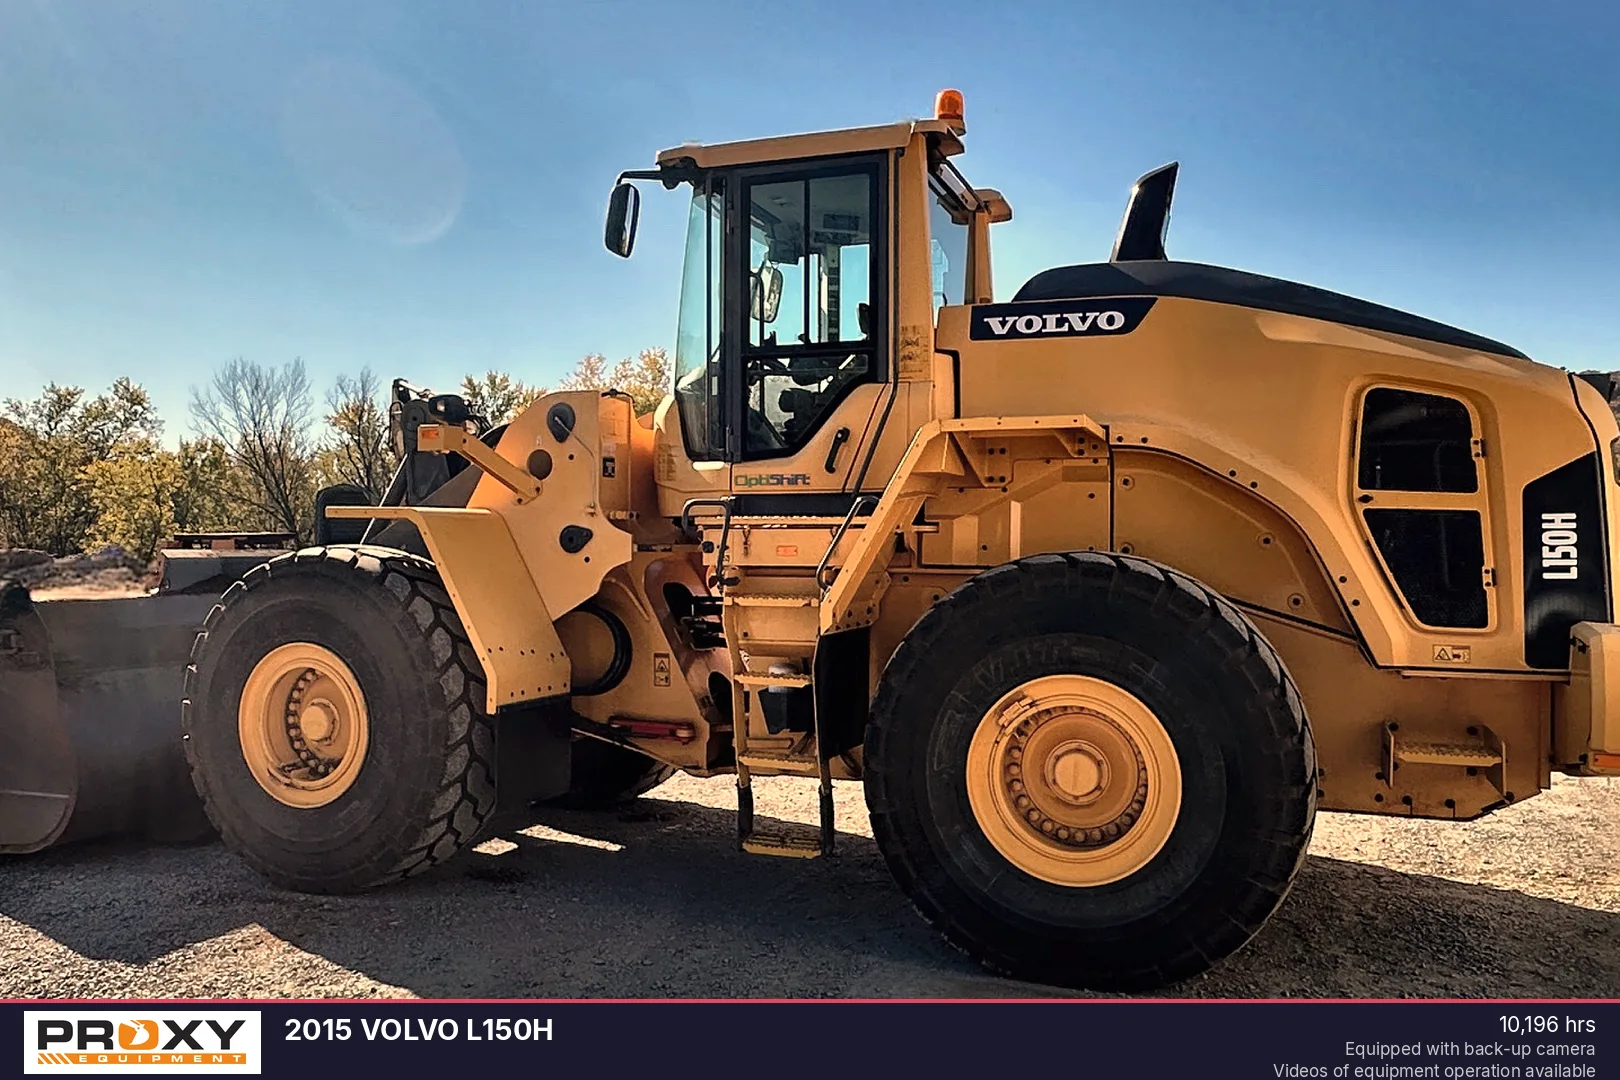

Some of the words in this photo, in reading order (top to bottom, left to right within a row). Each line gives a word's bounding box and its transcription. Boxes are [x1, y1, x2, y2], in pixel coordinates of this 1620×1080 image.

[984, 311, 1125, 335] VOLVO
[734, 473, 811, 488] OptiShift
[1541, 512, 1578, 580] L150H
